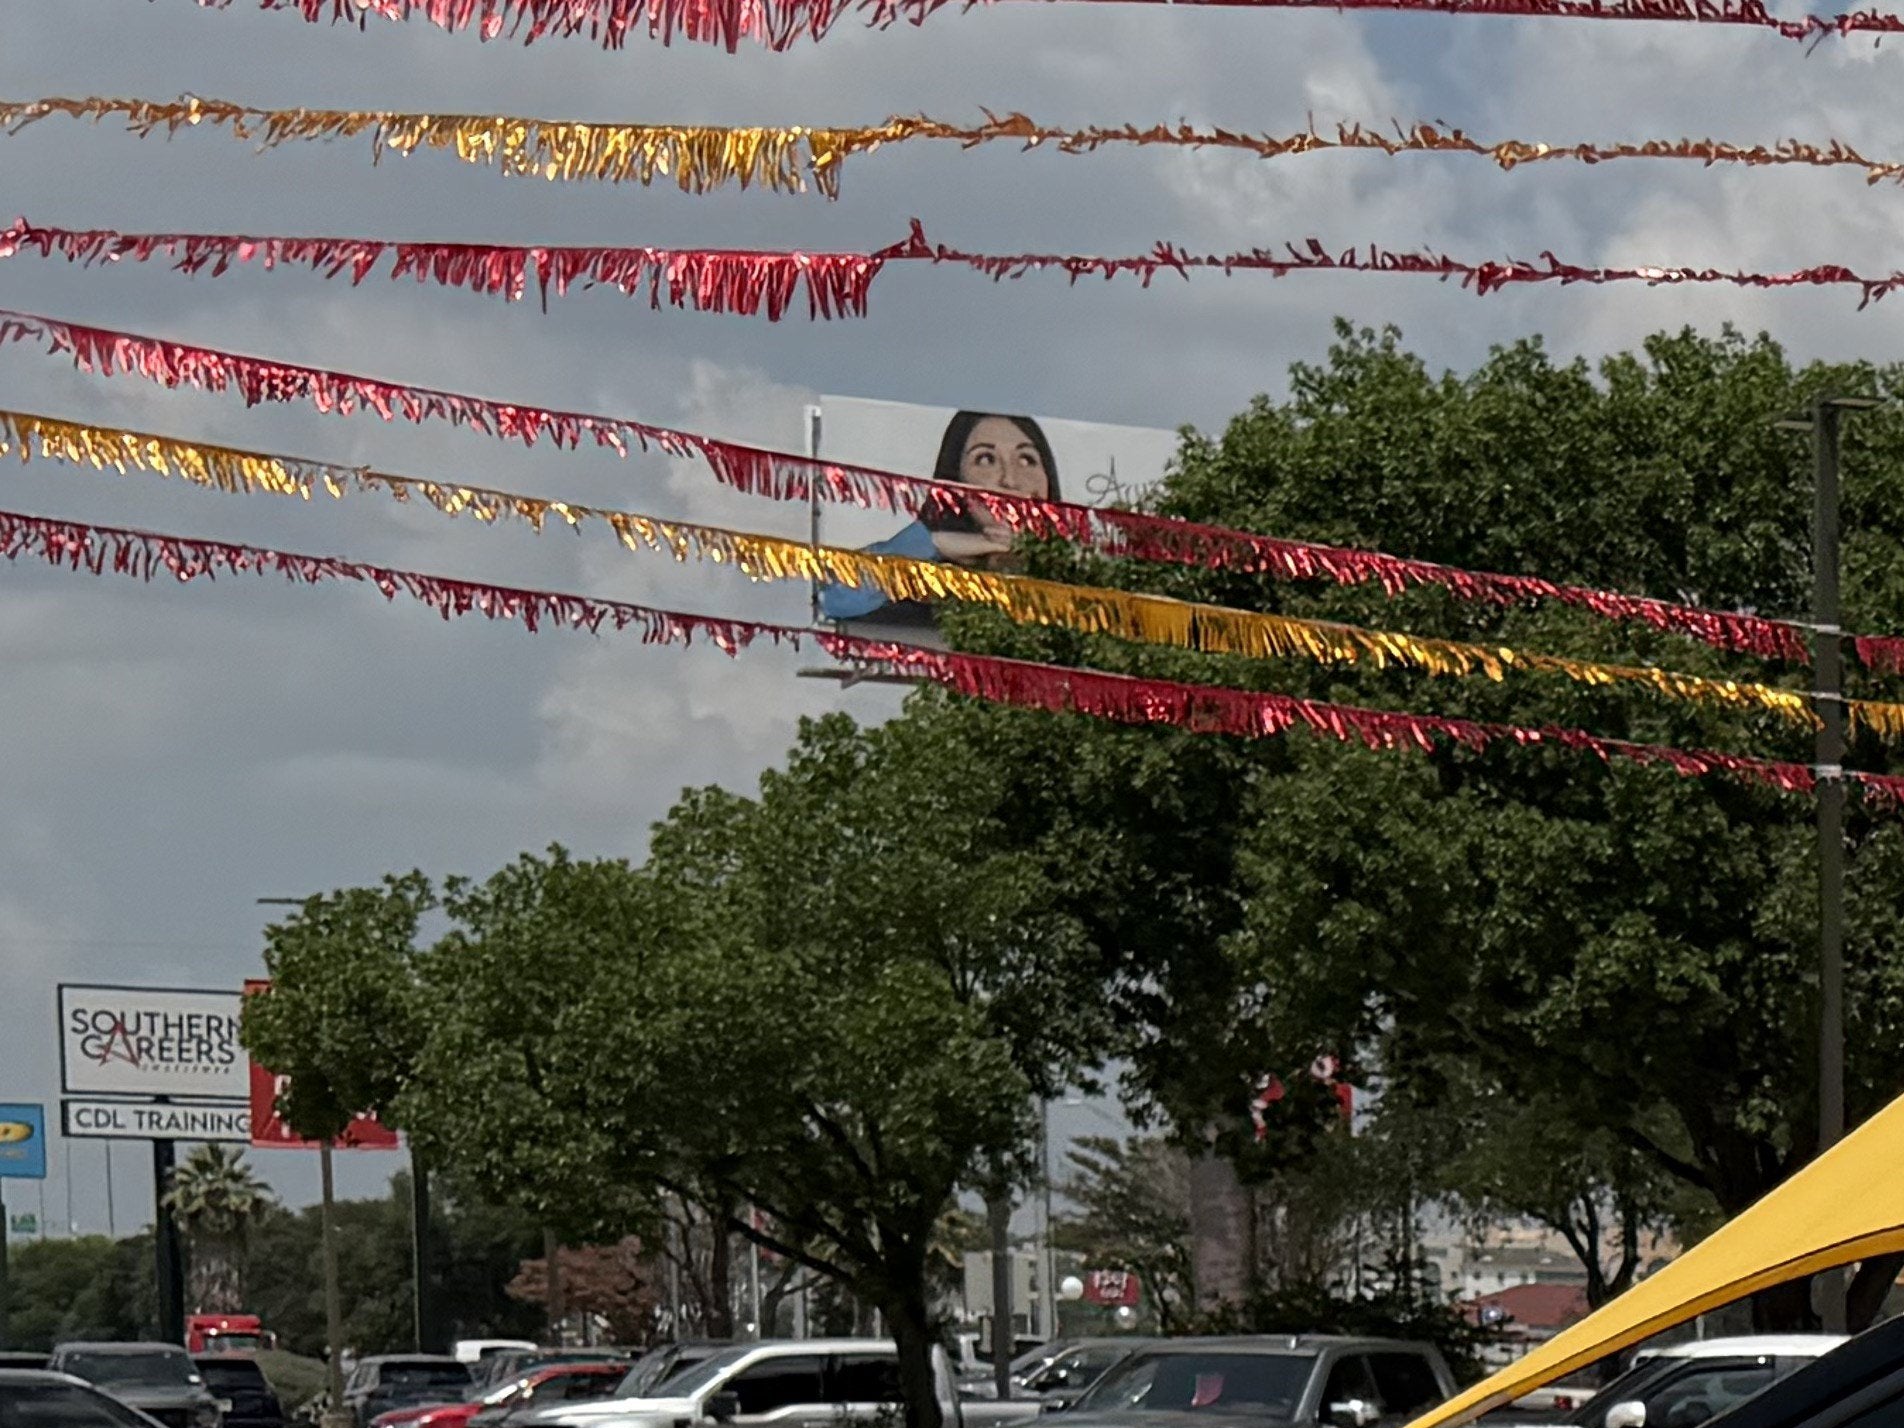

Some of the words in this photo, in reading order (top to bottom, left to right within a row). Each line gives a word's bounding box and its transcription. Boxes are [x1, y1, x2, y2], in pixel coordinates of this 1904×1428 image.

[70, 1008, 241, 1044] SOUTHERN
[80, 1024, 236, 1066] CAREERS
[75, 1108, 127, 1129] CDL
[133, 1110, 251, 1133] TRAINING
